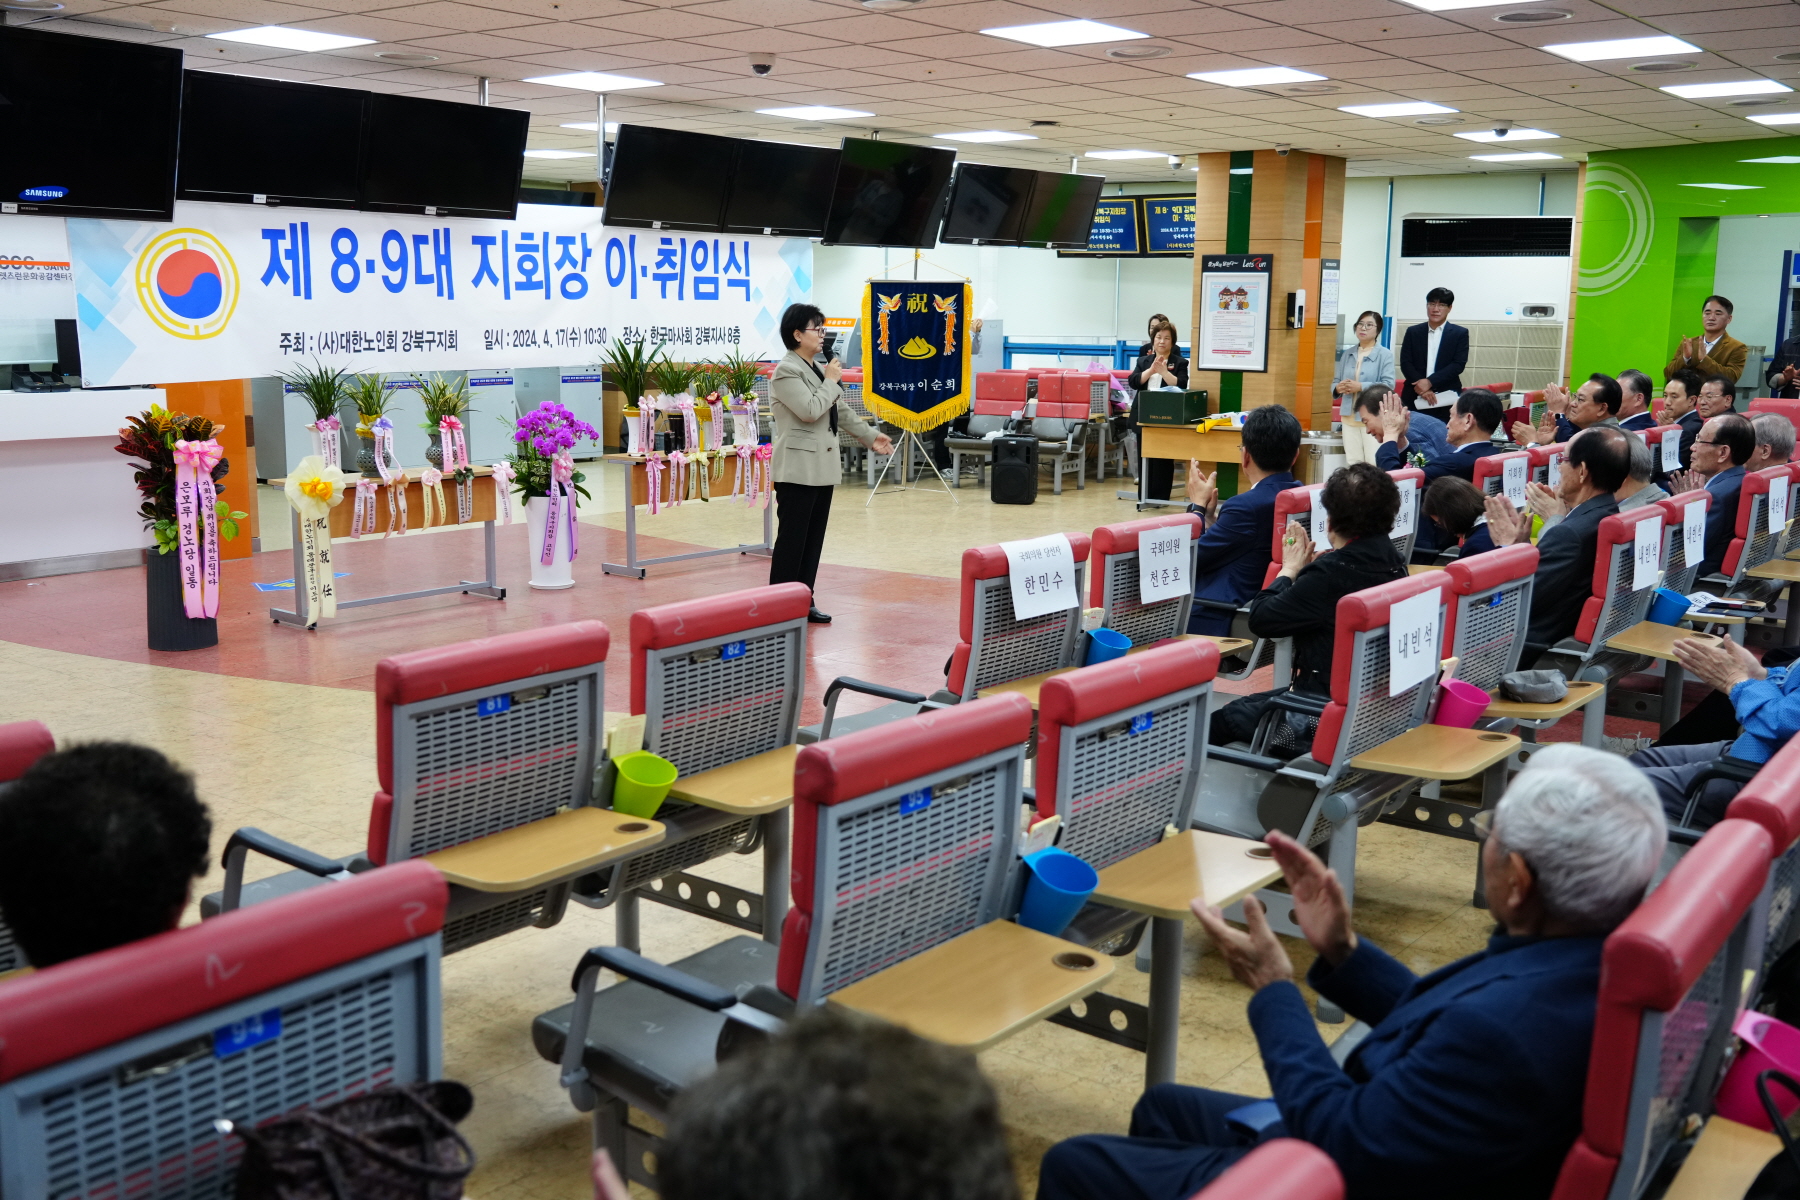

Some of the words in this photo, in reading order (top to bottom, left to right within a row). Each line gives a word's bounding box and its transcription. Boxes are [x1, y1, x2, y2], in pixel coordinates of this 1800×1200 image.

[25, 189, 63, 197] SAMSUNG
[260, 221, 312, 300] 제
[330, 226, 455, 300] 8·9대
[471, 230, 592, 300] 지회장
[605, 234, 751, 301] 이·취임식
[906, 292, 929, 314] 祝
[279, 331, 305, 354] 주최
[317, 330, 398, 354] (사)대한노인회
[402, 329, 459, 353] 강북구지회
[483, 328, 504, 349] 일시
[583, 326, 607, 346] 10:30
[622, 326, 642, 346] 장소
[650, 325, 693, 346] 한국마사회
[695, 325, 726, 346] 강북지사
[728, 325, 741, 345] 8층
[918, 378, 956, 391] 이순희
[1043, 545, 1061, 559] 당선자
[1150, 538, 1181, 557] 국회의원
[185, 564, 198, 589] 일동
[1024, 571, 1064, 596] 한민수
[1149, 566, 1181, 588] 천준호
[728, 642, 741, 655] 82
[1397, 622, 1433, 659] 내빈석
[486, 696, 502, 711] 81
[1135, 713, 1147, 729] 96
[908, 788, 925, 808] 95
[231, 1013, 264, 1044] 94
